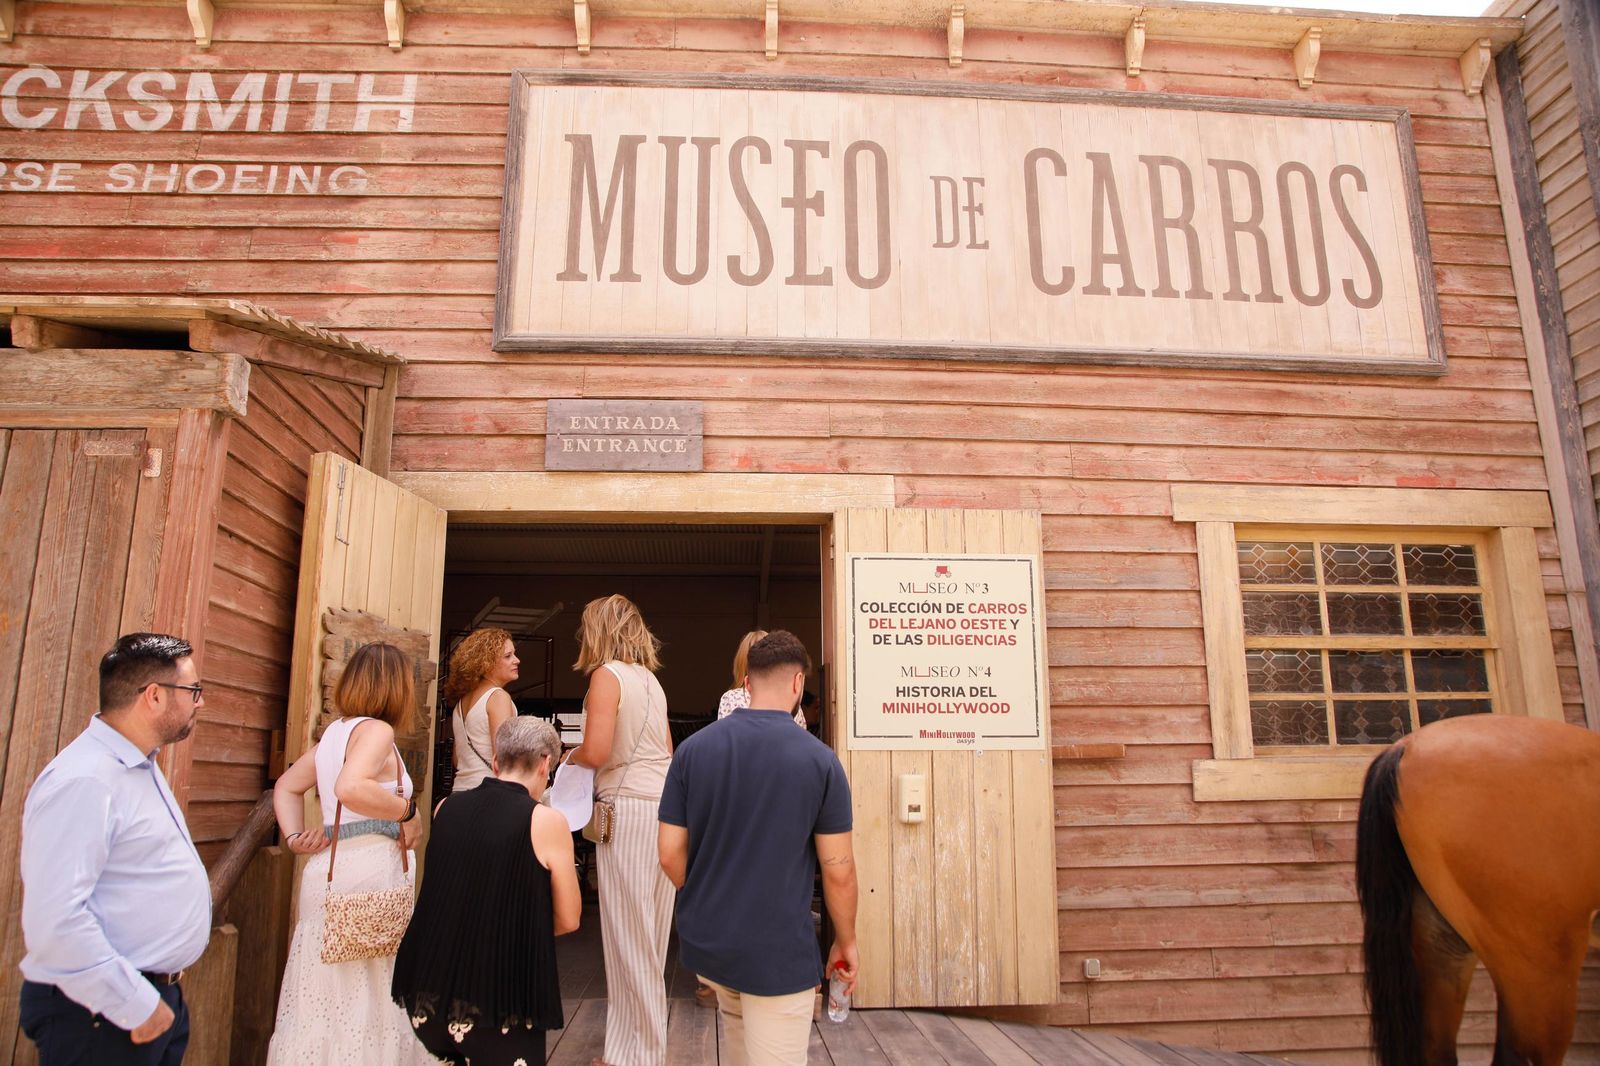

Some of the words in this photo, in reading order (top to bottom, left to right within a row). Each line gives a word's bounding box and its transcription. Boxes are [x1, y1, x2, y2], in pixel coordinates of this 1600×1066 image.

[1, 65, 418, 132] CKSMITH
[0, 162, 82, 192] SE
[105, 163, 370, 195] SHOEING
[556, 134, 891, 289] MUSEO
[929, 175, 989, 250] DE
[1024, 147, 1383, 309] CARROS
[570, 416, 680, 430] ENTRADA
[562, 438, 687, 452] ENTRANCE
[899, 582, 958, 594] MUSEO
[860, 600, 942, 614] COLECCIÓN
[945, 603, 965, 614] DE
[968, 603, 1028, 614] CARROS
[868, 618, 896, 629] DEL
[900, 618, 956, 630] LEJANO
[960, 618, 1007, 630] OESTE
[1010, 619, 1020, 630] Y
[872, 634, 892, 645] DE
[895, 634, 923, 645] LAS
[927, 635, 1017, 646] DILIGENCIAS
[901, 666, 960, 678] MUSEO
[896, 686, 966, 697] HISTORIA
[969, 686, 997, 697] DEL
[882, 702, 1010, 714] MINIHOLLYWOOD
